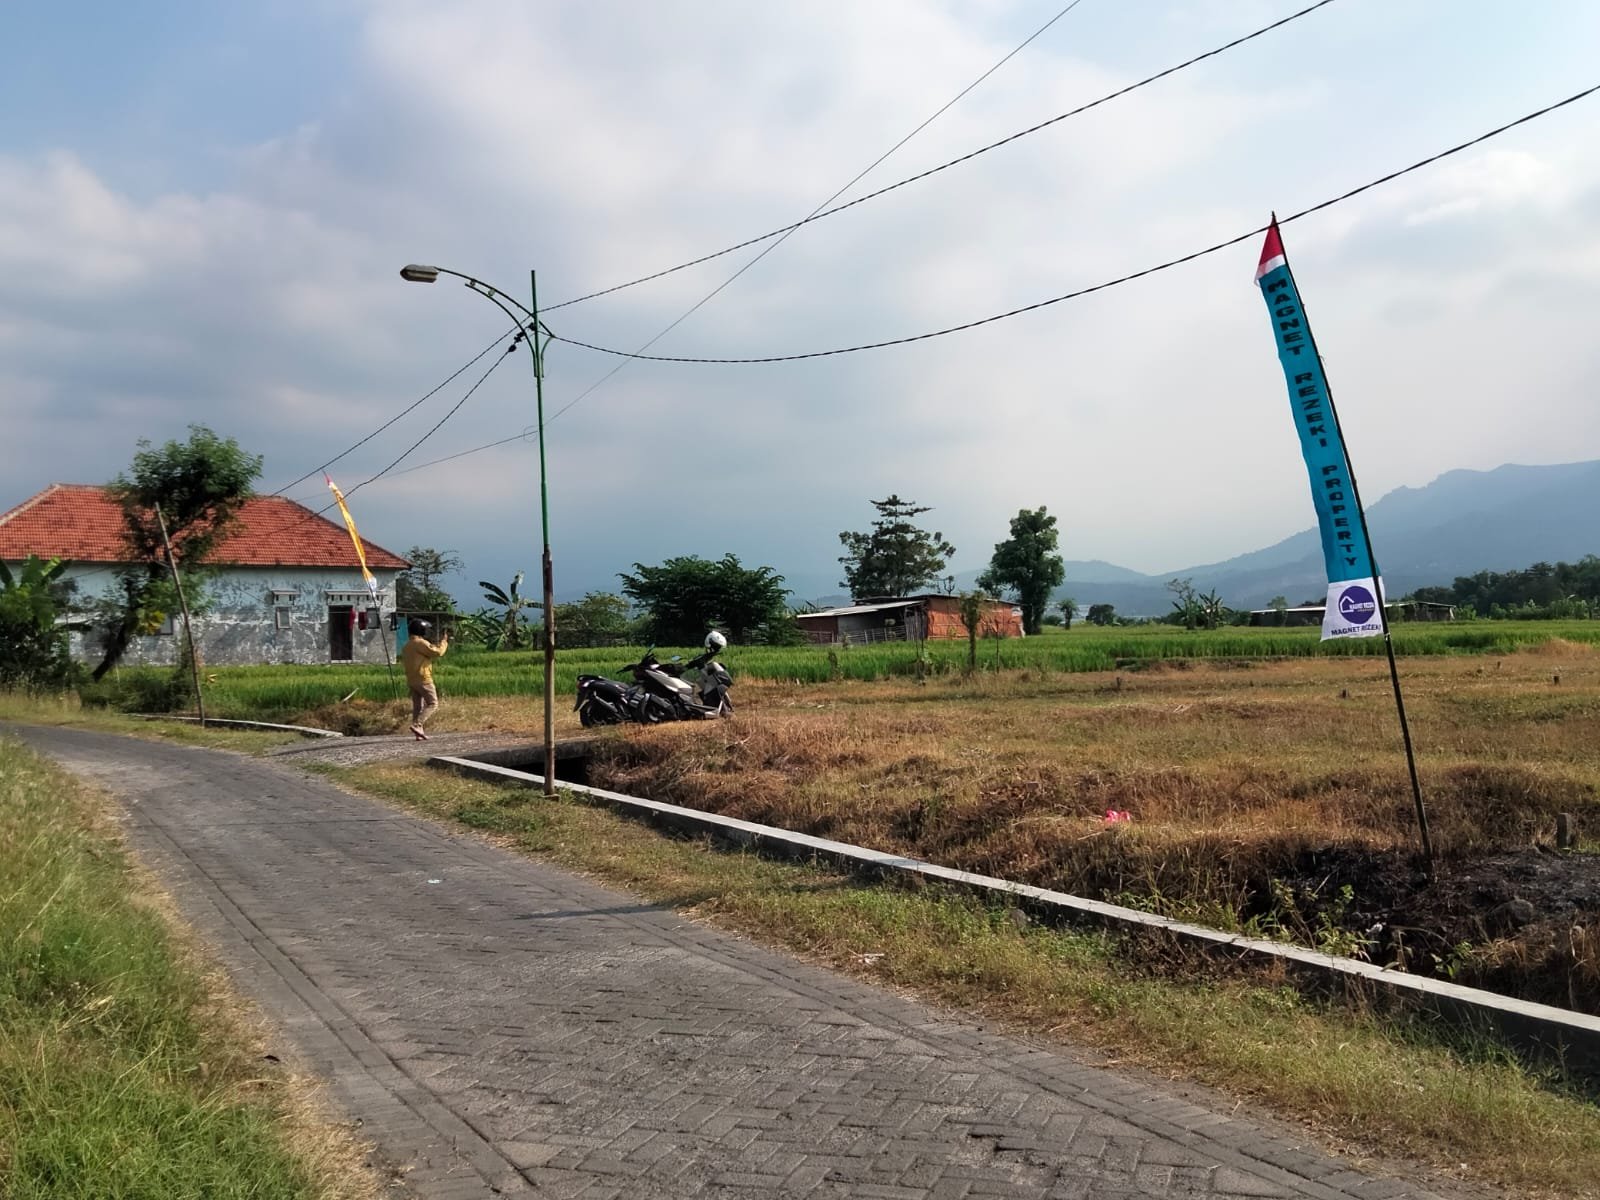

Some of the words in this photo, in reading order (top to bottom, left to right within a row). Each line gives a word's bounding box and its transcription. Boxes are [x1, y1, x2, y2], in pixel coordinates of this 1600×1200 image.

[1268, 279, 1305, 356] MAGNET
[1294, 372, 1327, 448] REZEKI
[1322, 465, 1356, 566] PROPERTY
[1331, 626, 1360, 636] MAGNET
